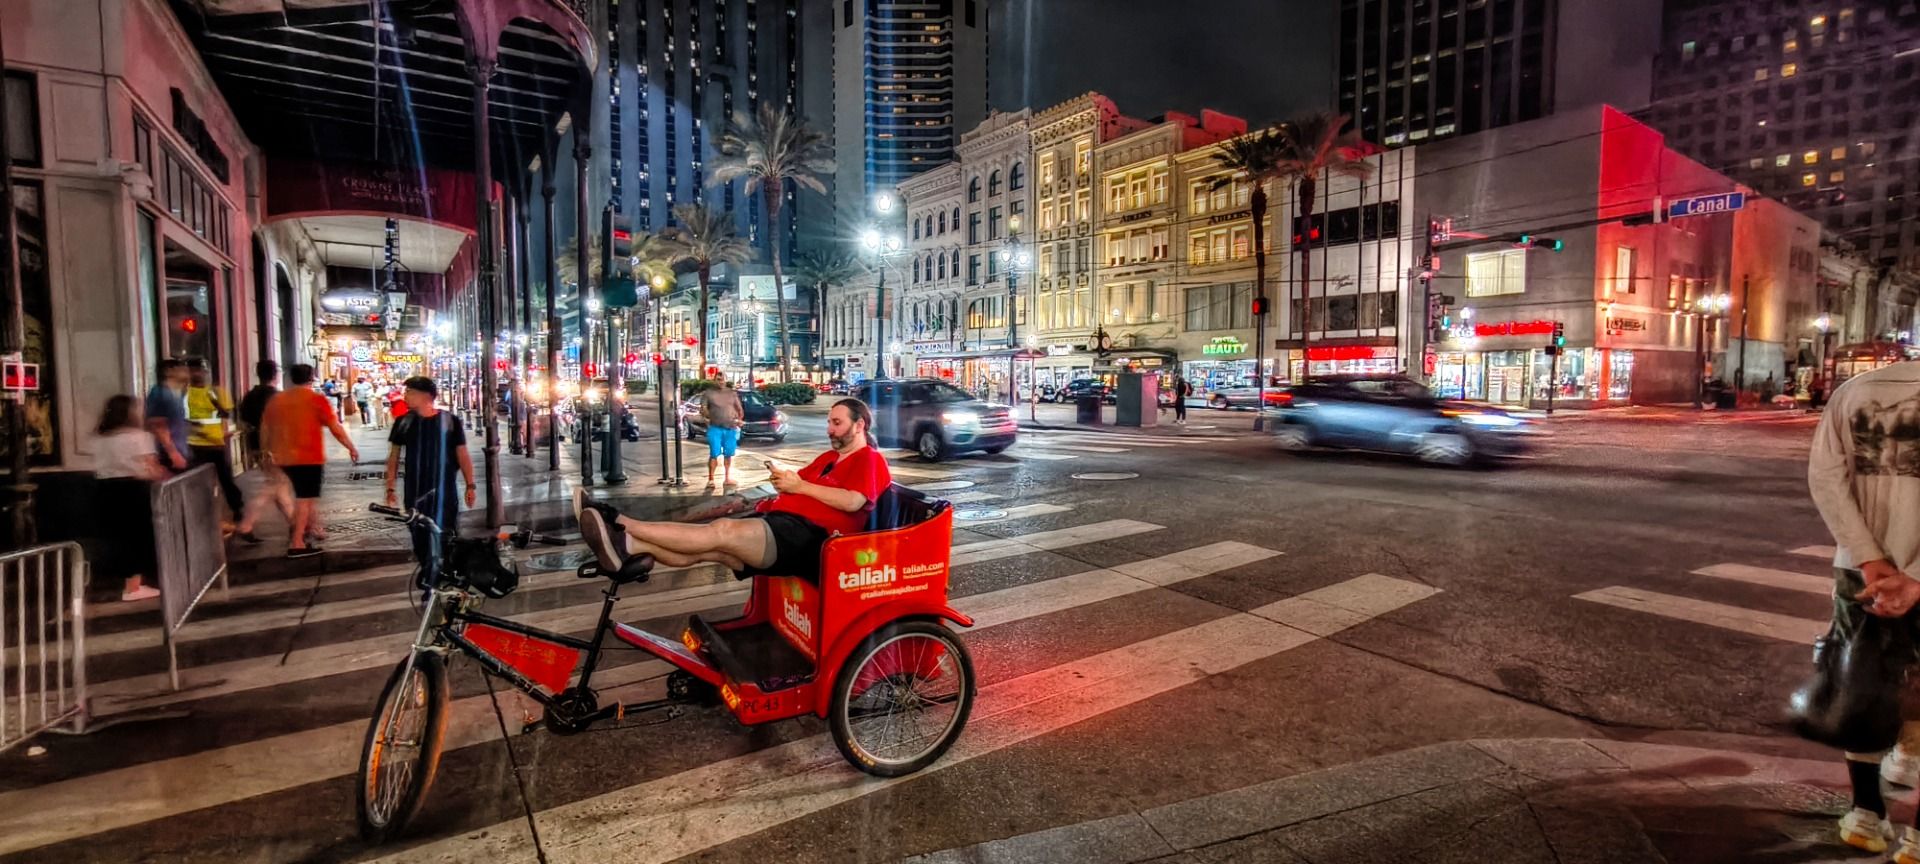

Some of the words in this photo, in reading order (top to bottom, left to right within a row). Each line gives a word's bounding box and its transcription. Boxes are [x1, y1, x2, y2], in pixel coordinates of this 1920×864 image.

[1688, 195, 1730, 214] Canal
[1202, 343, 1249, 354] BEAUTY
[838, 564, 897, 589] taliah
[902, 562, 945, 575] taliah.com
[783, 597, 812, 639] taliah
